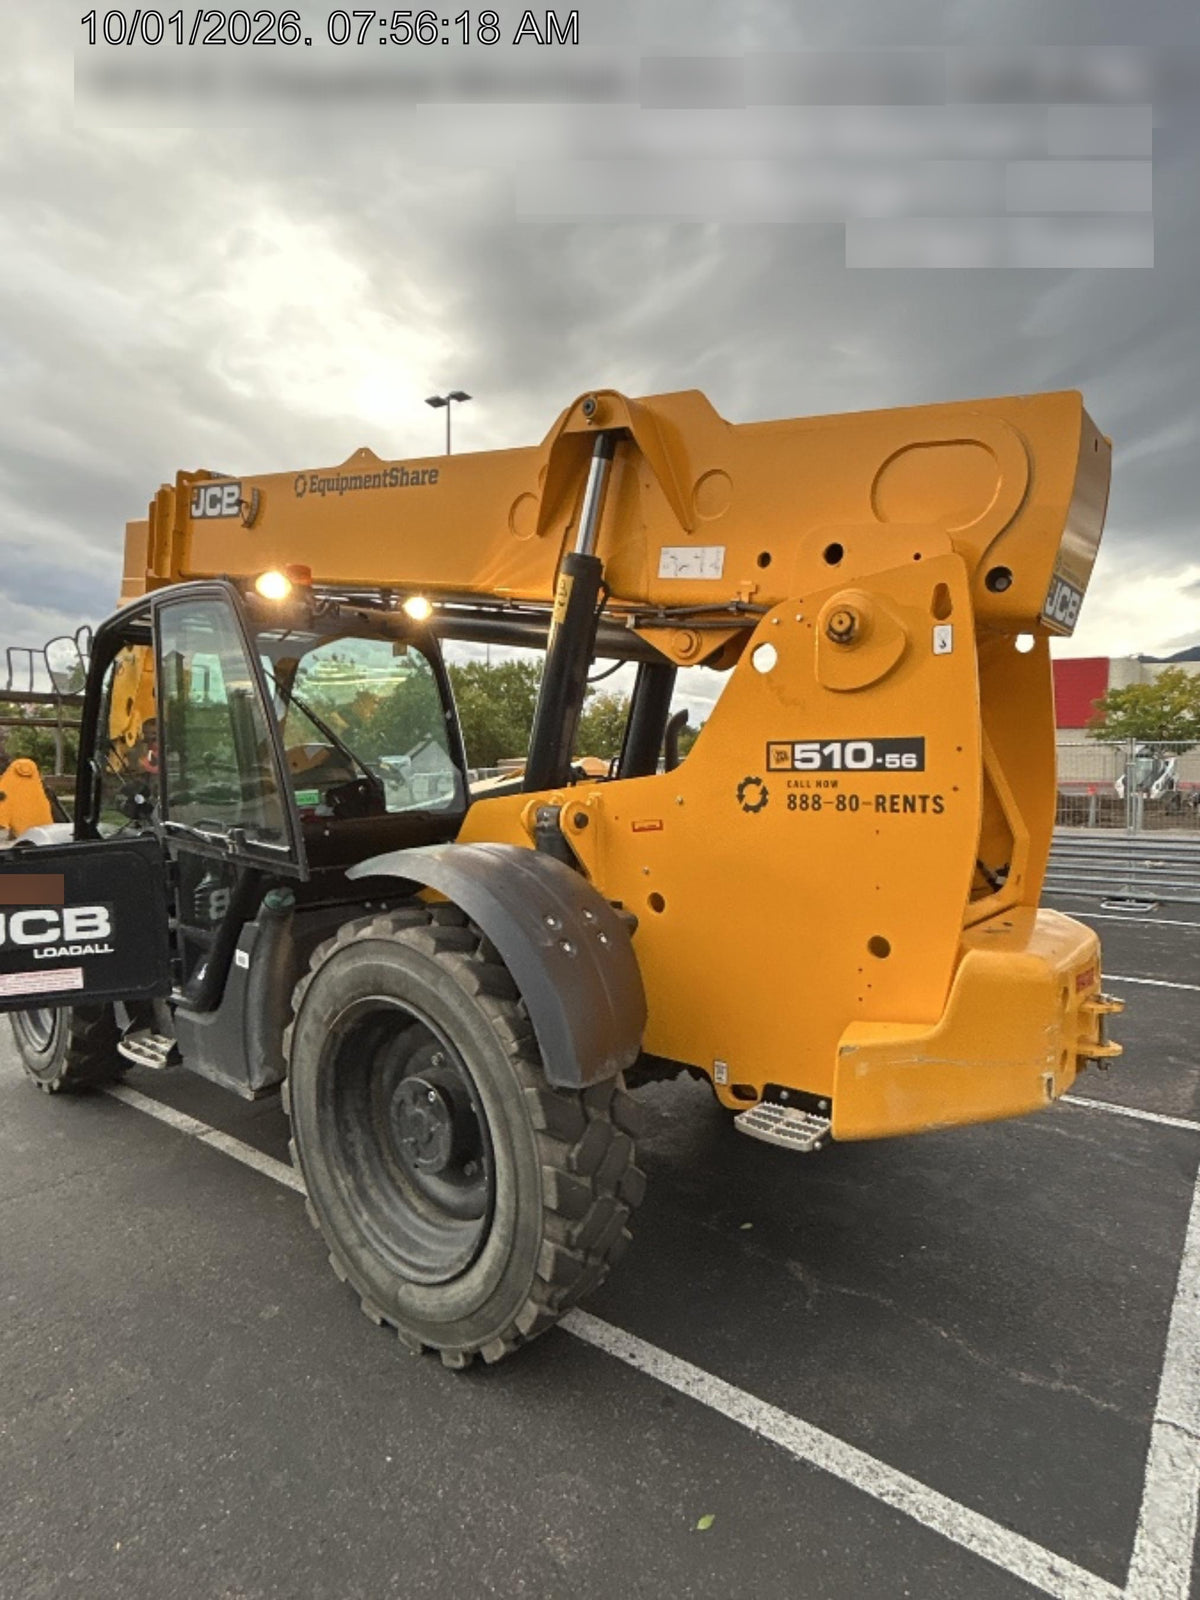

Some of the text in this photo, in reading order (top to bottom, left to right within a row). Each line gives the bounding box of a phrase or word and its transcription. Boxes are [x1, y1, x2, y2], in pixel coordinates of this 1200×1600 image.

[309, 466, 439, 496] EquipmentShare
[191, 484, 241, 517] JCB
[1045, 579, 1081, 627] JCB
[787, 780, 838, 788] CALL NOW
[787, 794, 944, 814] 888-80-RENTS
[33, 944, 115, 959] LOADALL
